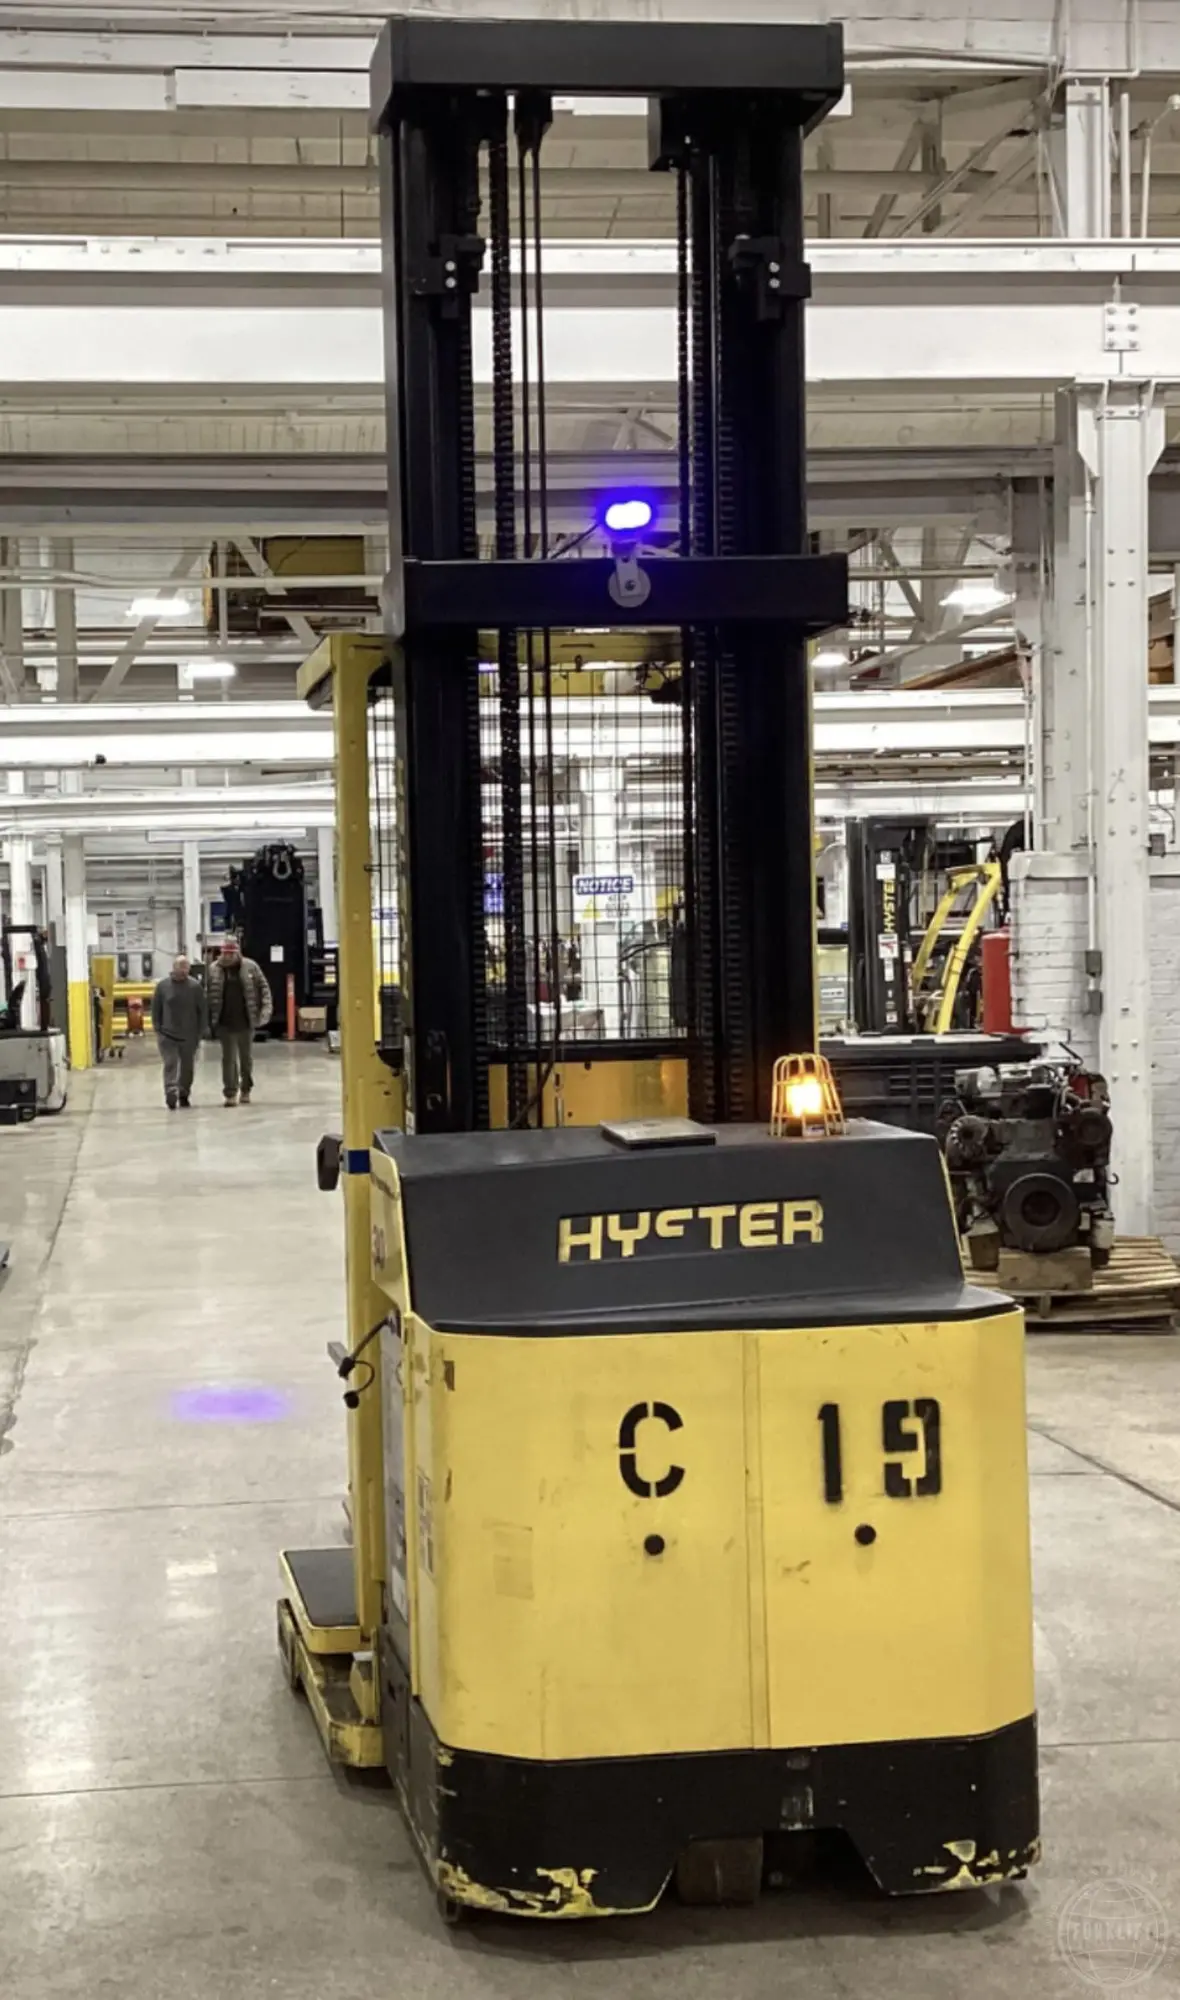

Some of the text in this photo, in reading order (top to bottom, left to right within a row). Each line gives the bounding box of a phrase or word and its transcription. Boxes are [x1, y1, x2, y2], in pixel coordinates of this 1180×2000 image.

[578, 878, 632, 893] NOTICE
[883, 879, 895, 932] HYSTE
[619, 1401, 685, 1498] C
